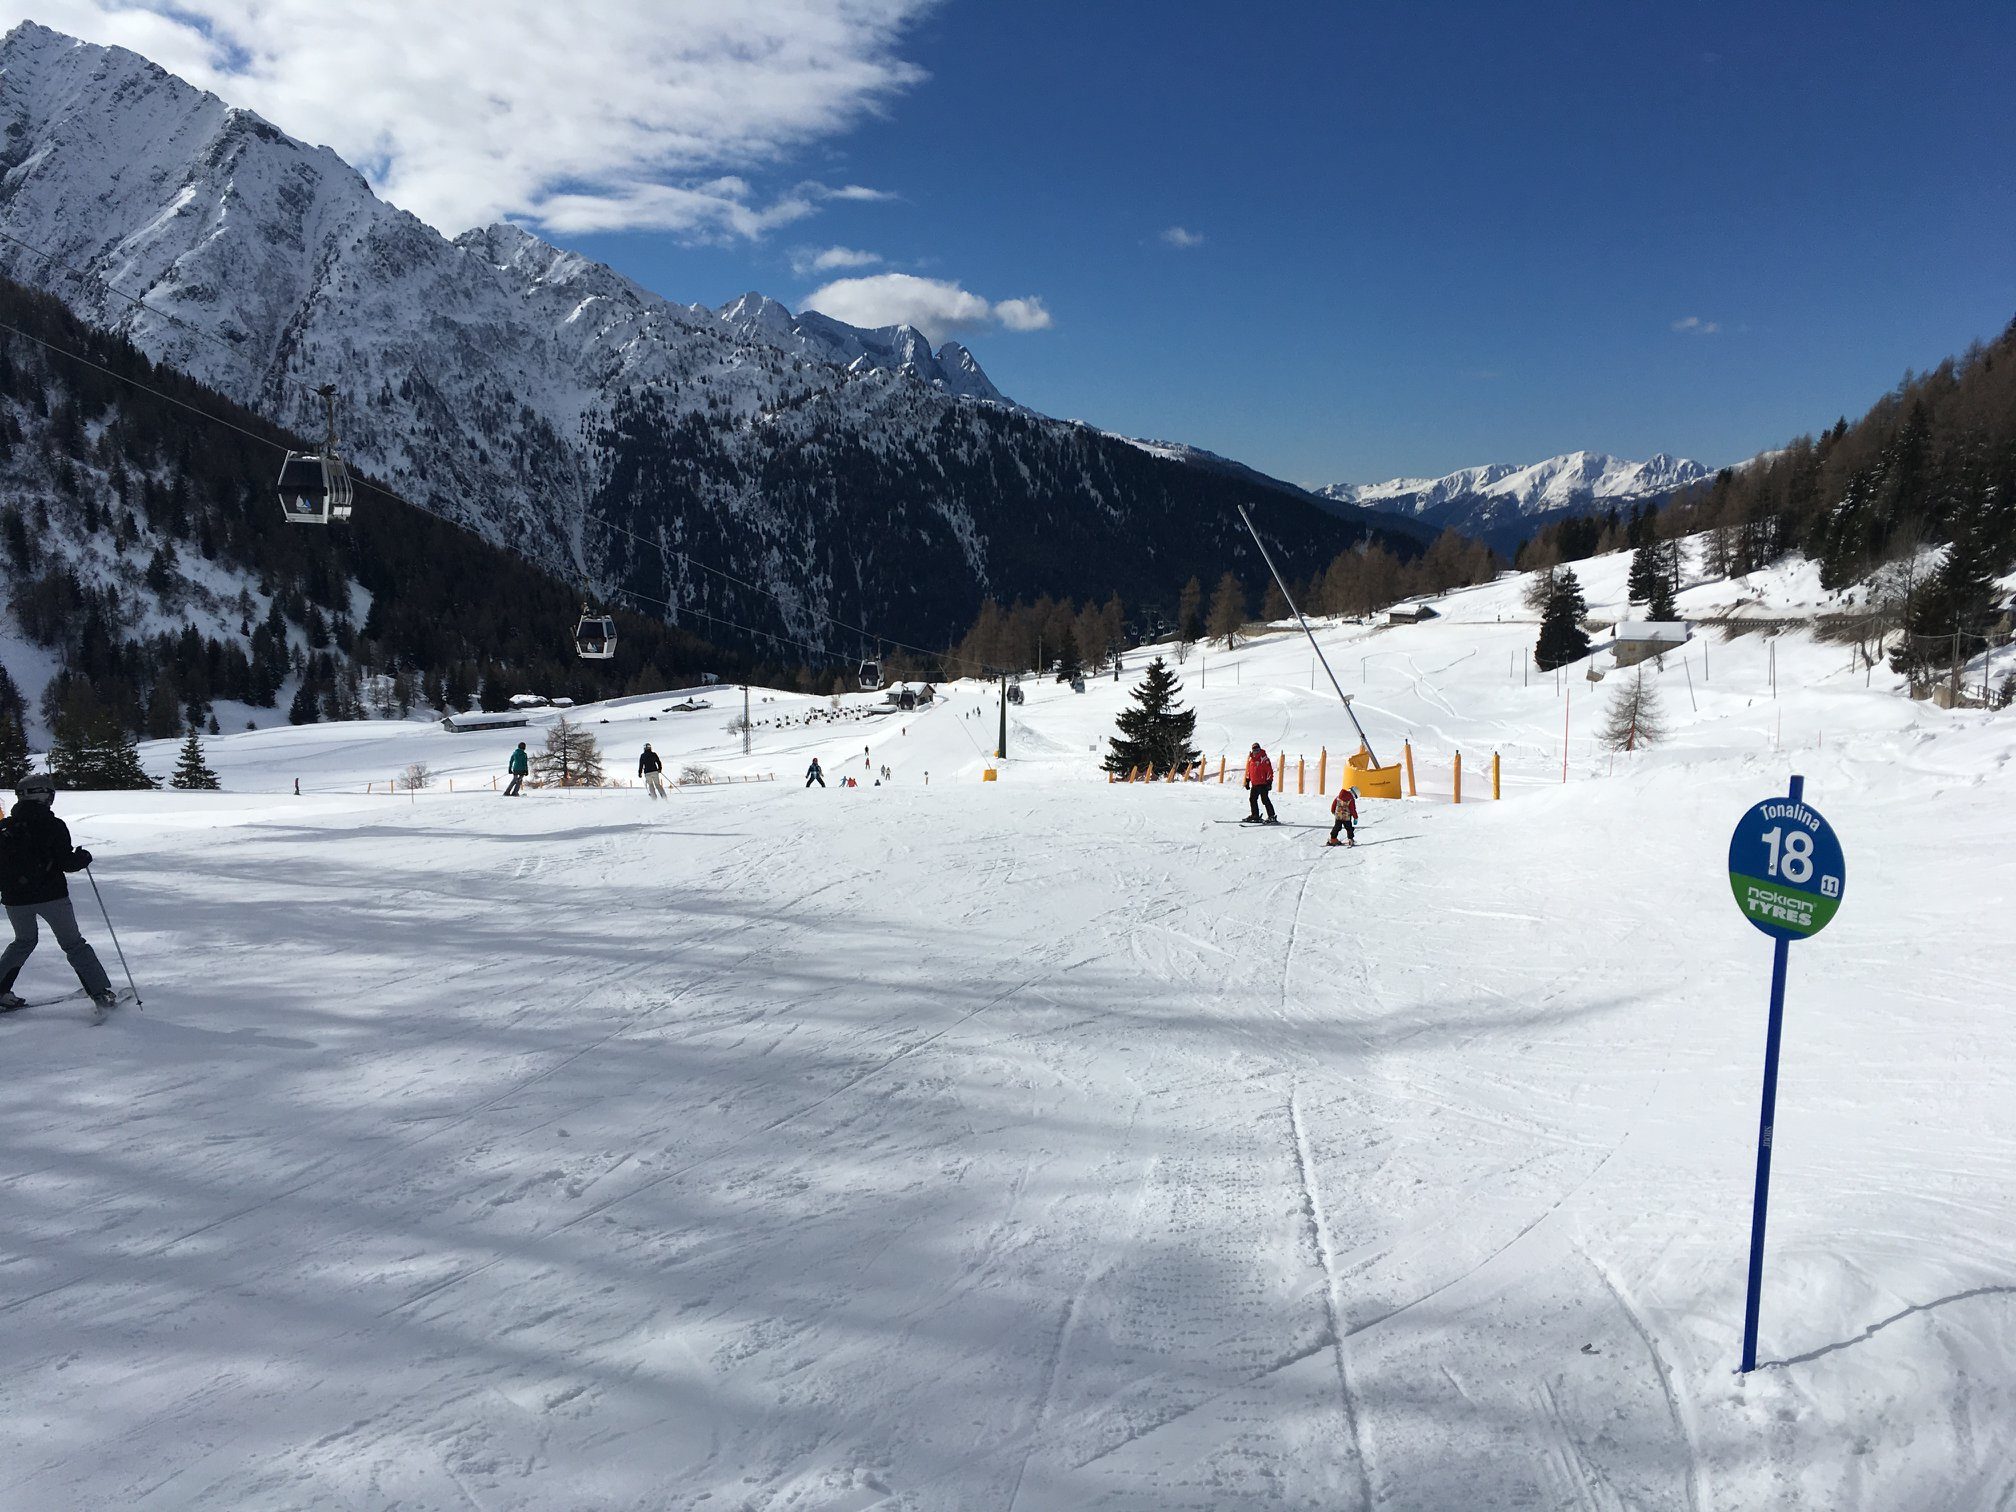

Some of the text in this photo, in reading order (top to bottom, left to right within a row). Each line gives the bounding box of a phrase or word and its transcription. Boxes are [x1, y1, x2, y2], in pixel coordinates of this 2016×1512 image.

[1760, 804, 1820, 832] Tonalina
[1761, 826, 1814, 883] 18
[1748, 886, 1814, 912] nokian
[1822, 878, 1837, 894] 11
[1747, 897, 1812, 926] TYRES
